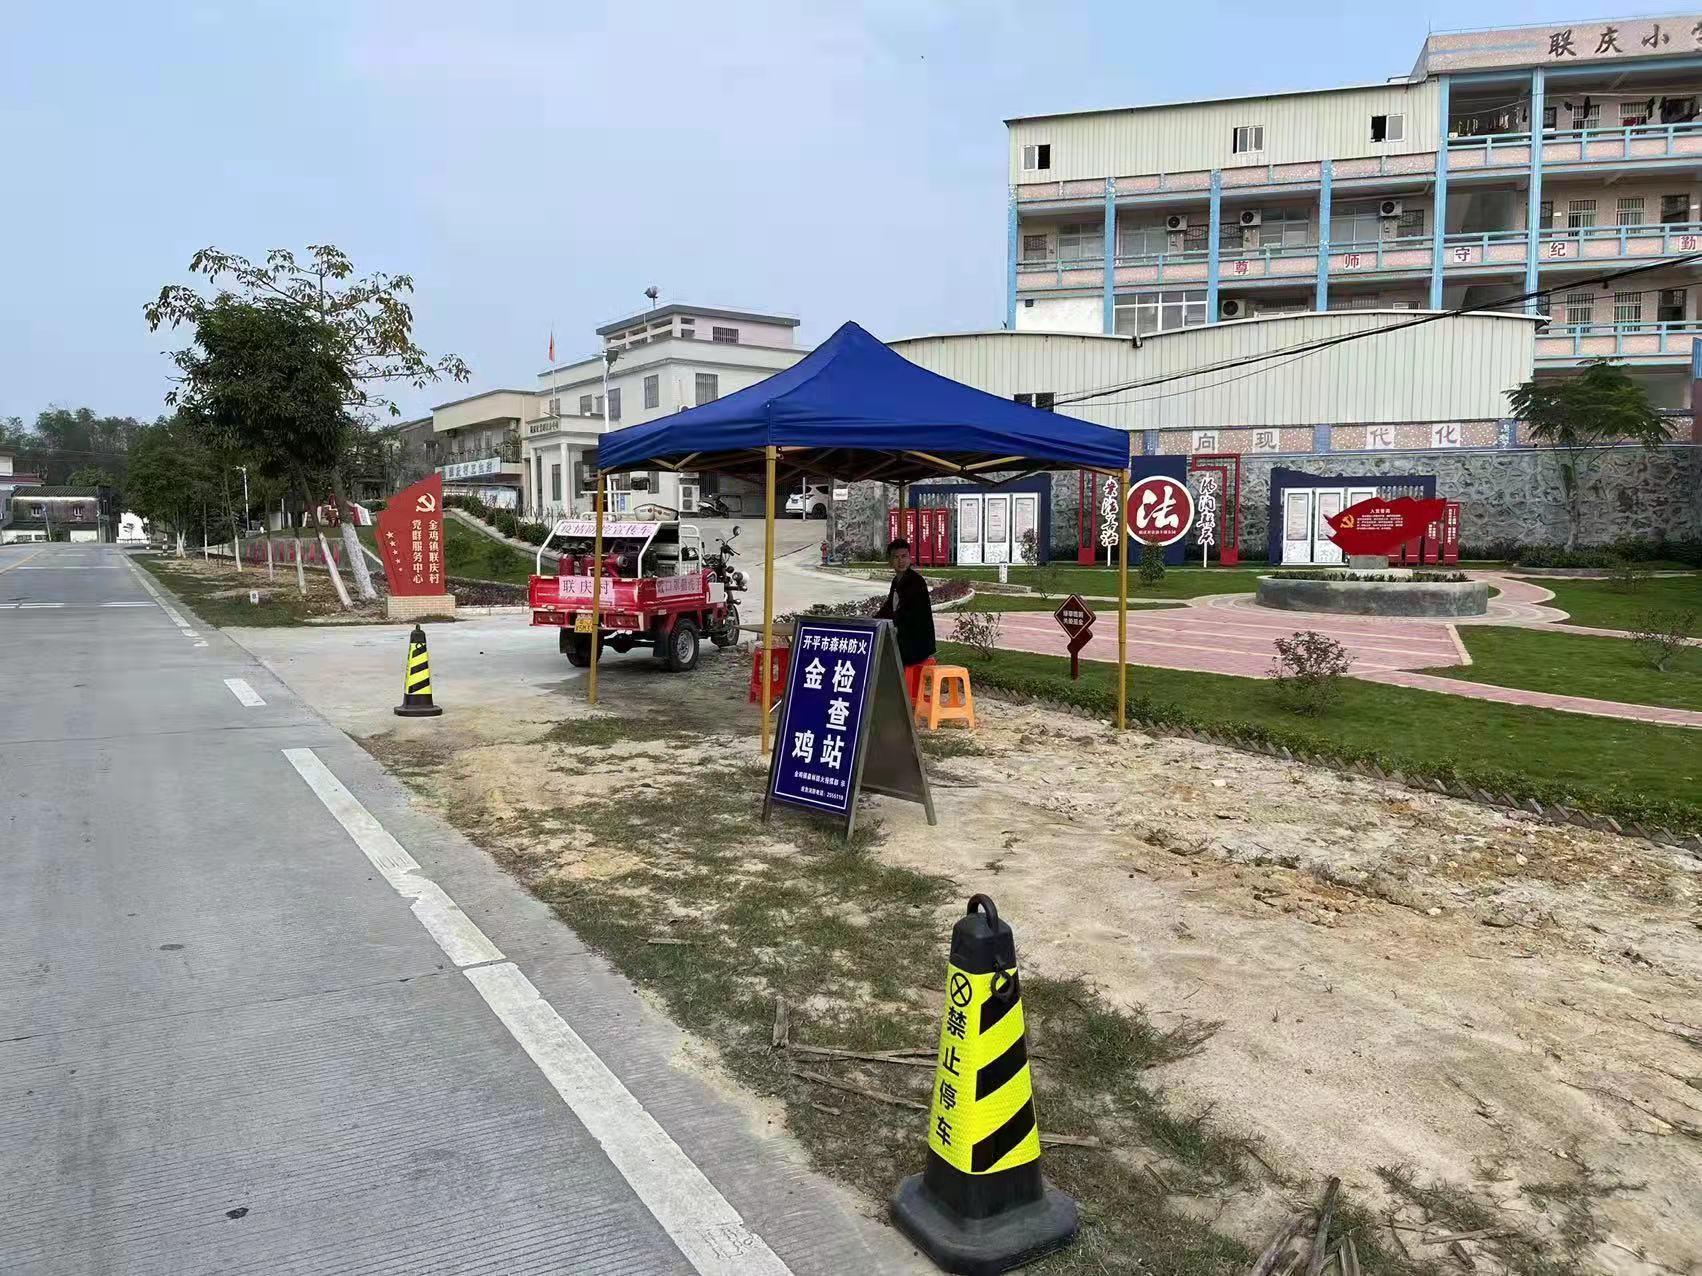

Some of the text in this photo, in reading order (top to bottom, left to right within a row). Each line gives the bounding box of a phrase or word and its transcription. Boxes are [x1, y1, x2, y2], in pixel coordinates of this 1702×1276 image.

[1195, 426, 1458, 451] 向现代化
[1136, 485, 1179, 529] 法
[412, 519, 423, 584] 党群服务中心
[429, 519, 440, 584] 金鸡镇联庆村
[803, 635, 868, 655] 开平市森林防火
[820, 659, 856, 770] 检查站
[936, 1005, 966, 1148] 禁止停车
